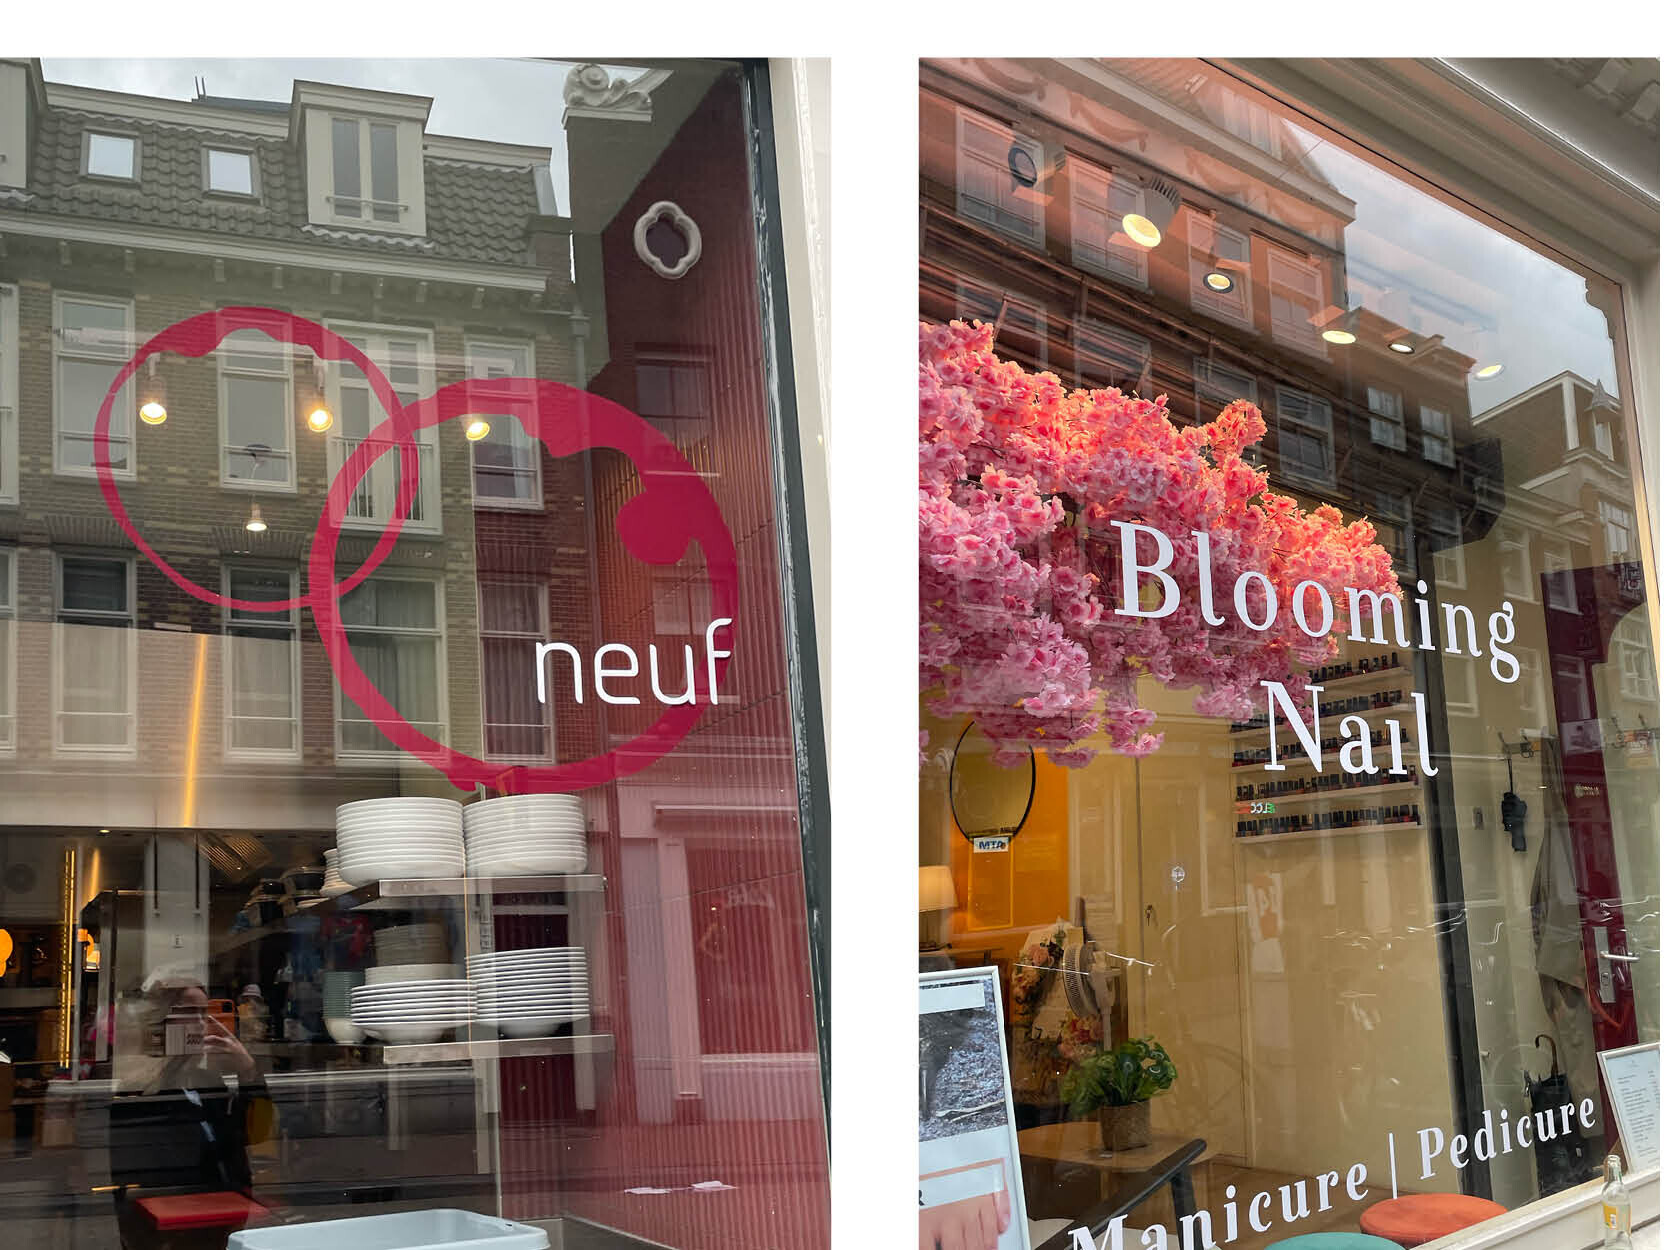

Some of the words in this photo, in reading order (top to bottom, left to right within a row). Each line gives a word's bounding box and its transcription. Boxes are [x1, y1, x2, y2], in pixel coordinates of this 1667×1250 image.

[535, 618, 733, 705] neuf
[1110, 519, 1521, 684] Blooming
[1260, 681, 1440, 777] Nail
[1068, 1160, 1369, 1250] Manicure
[1416, 1096, 1596, 1181] Pedicure
